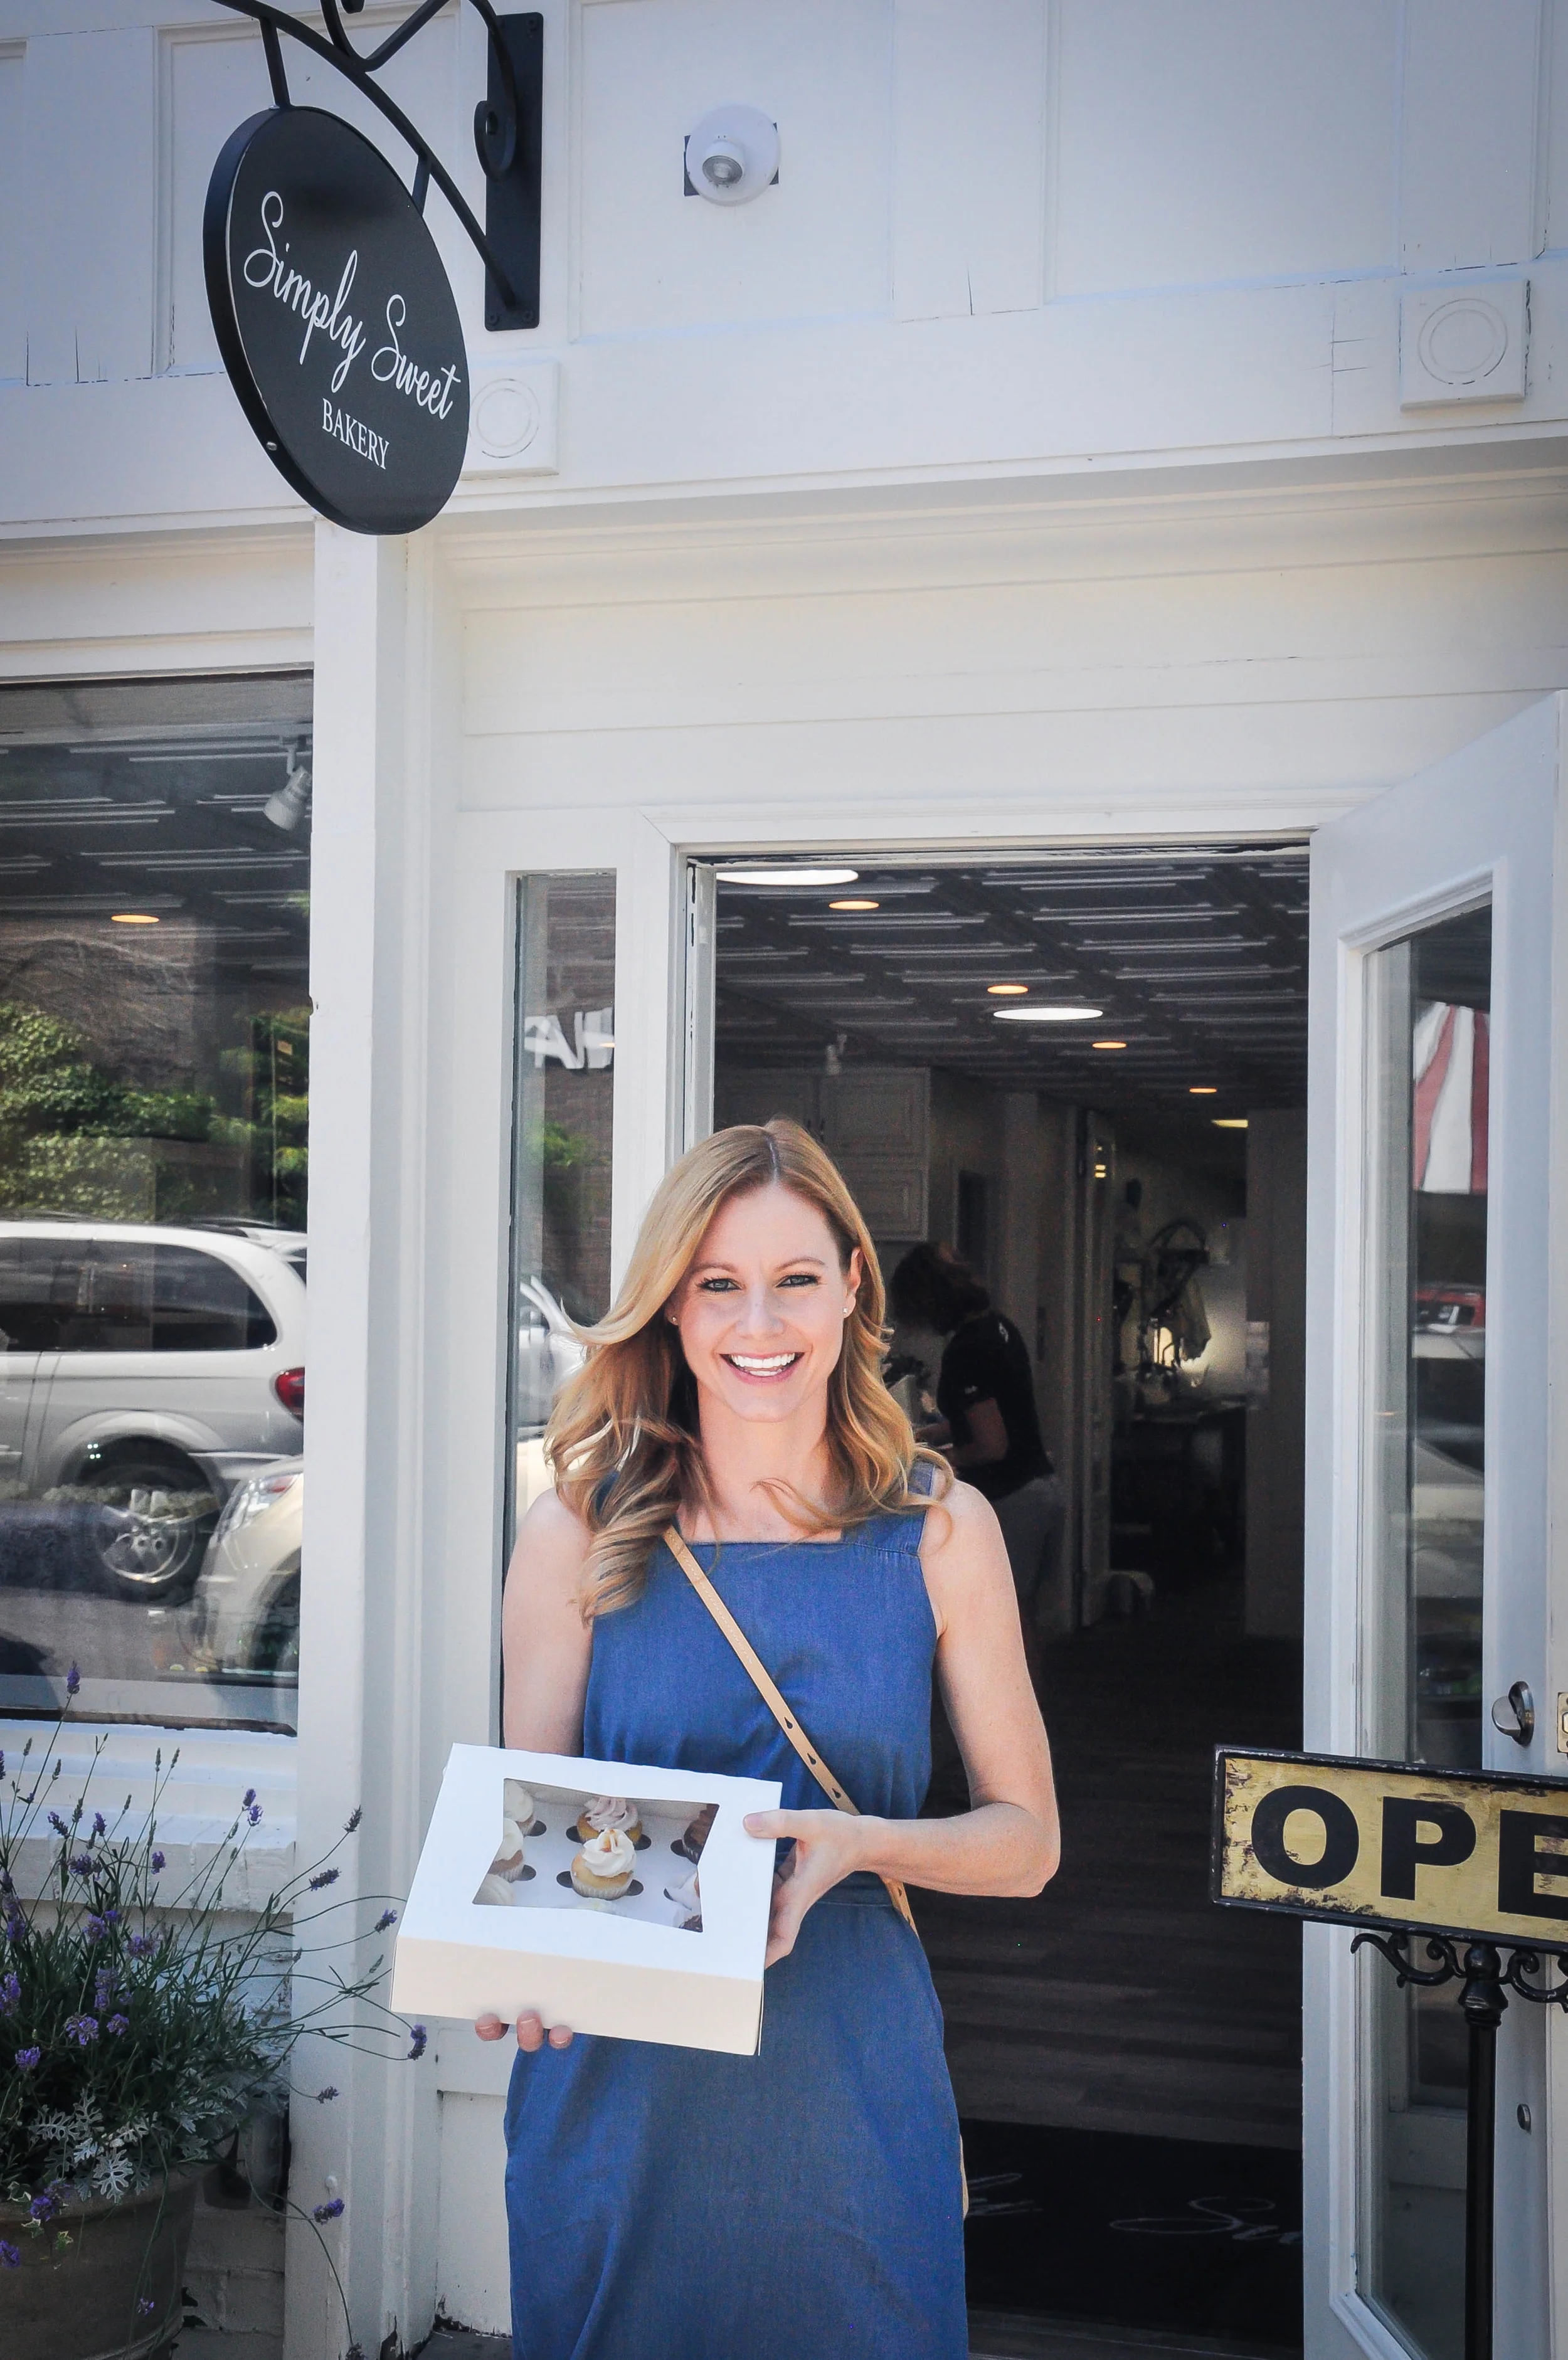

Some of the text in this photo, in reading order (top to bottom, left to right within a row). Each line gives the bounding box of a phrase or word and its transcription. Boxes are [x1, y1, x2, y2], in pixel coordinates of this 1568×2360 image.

[243, 191, 461, 420] Simply Sweet
[322, 398, 389, 470] BAKERY
